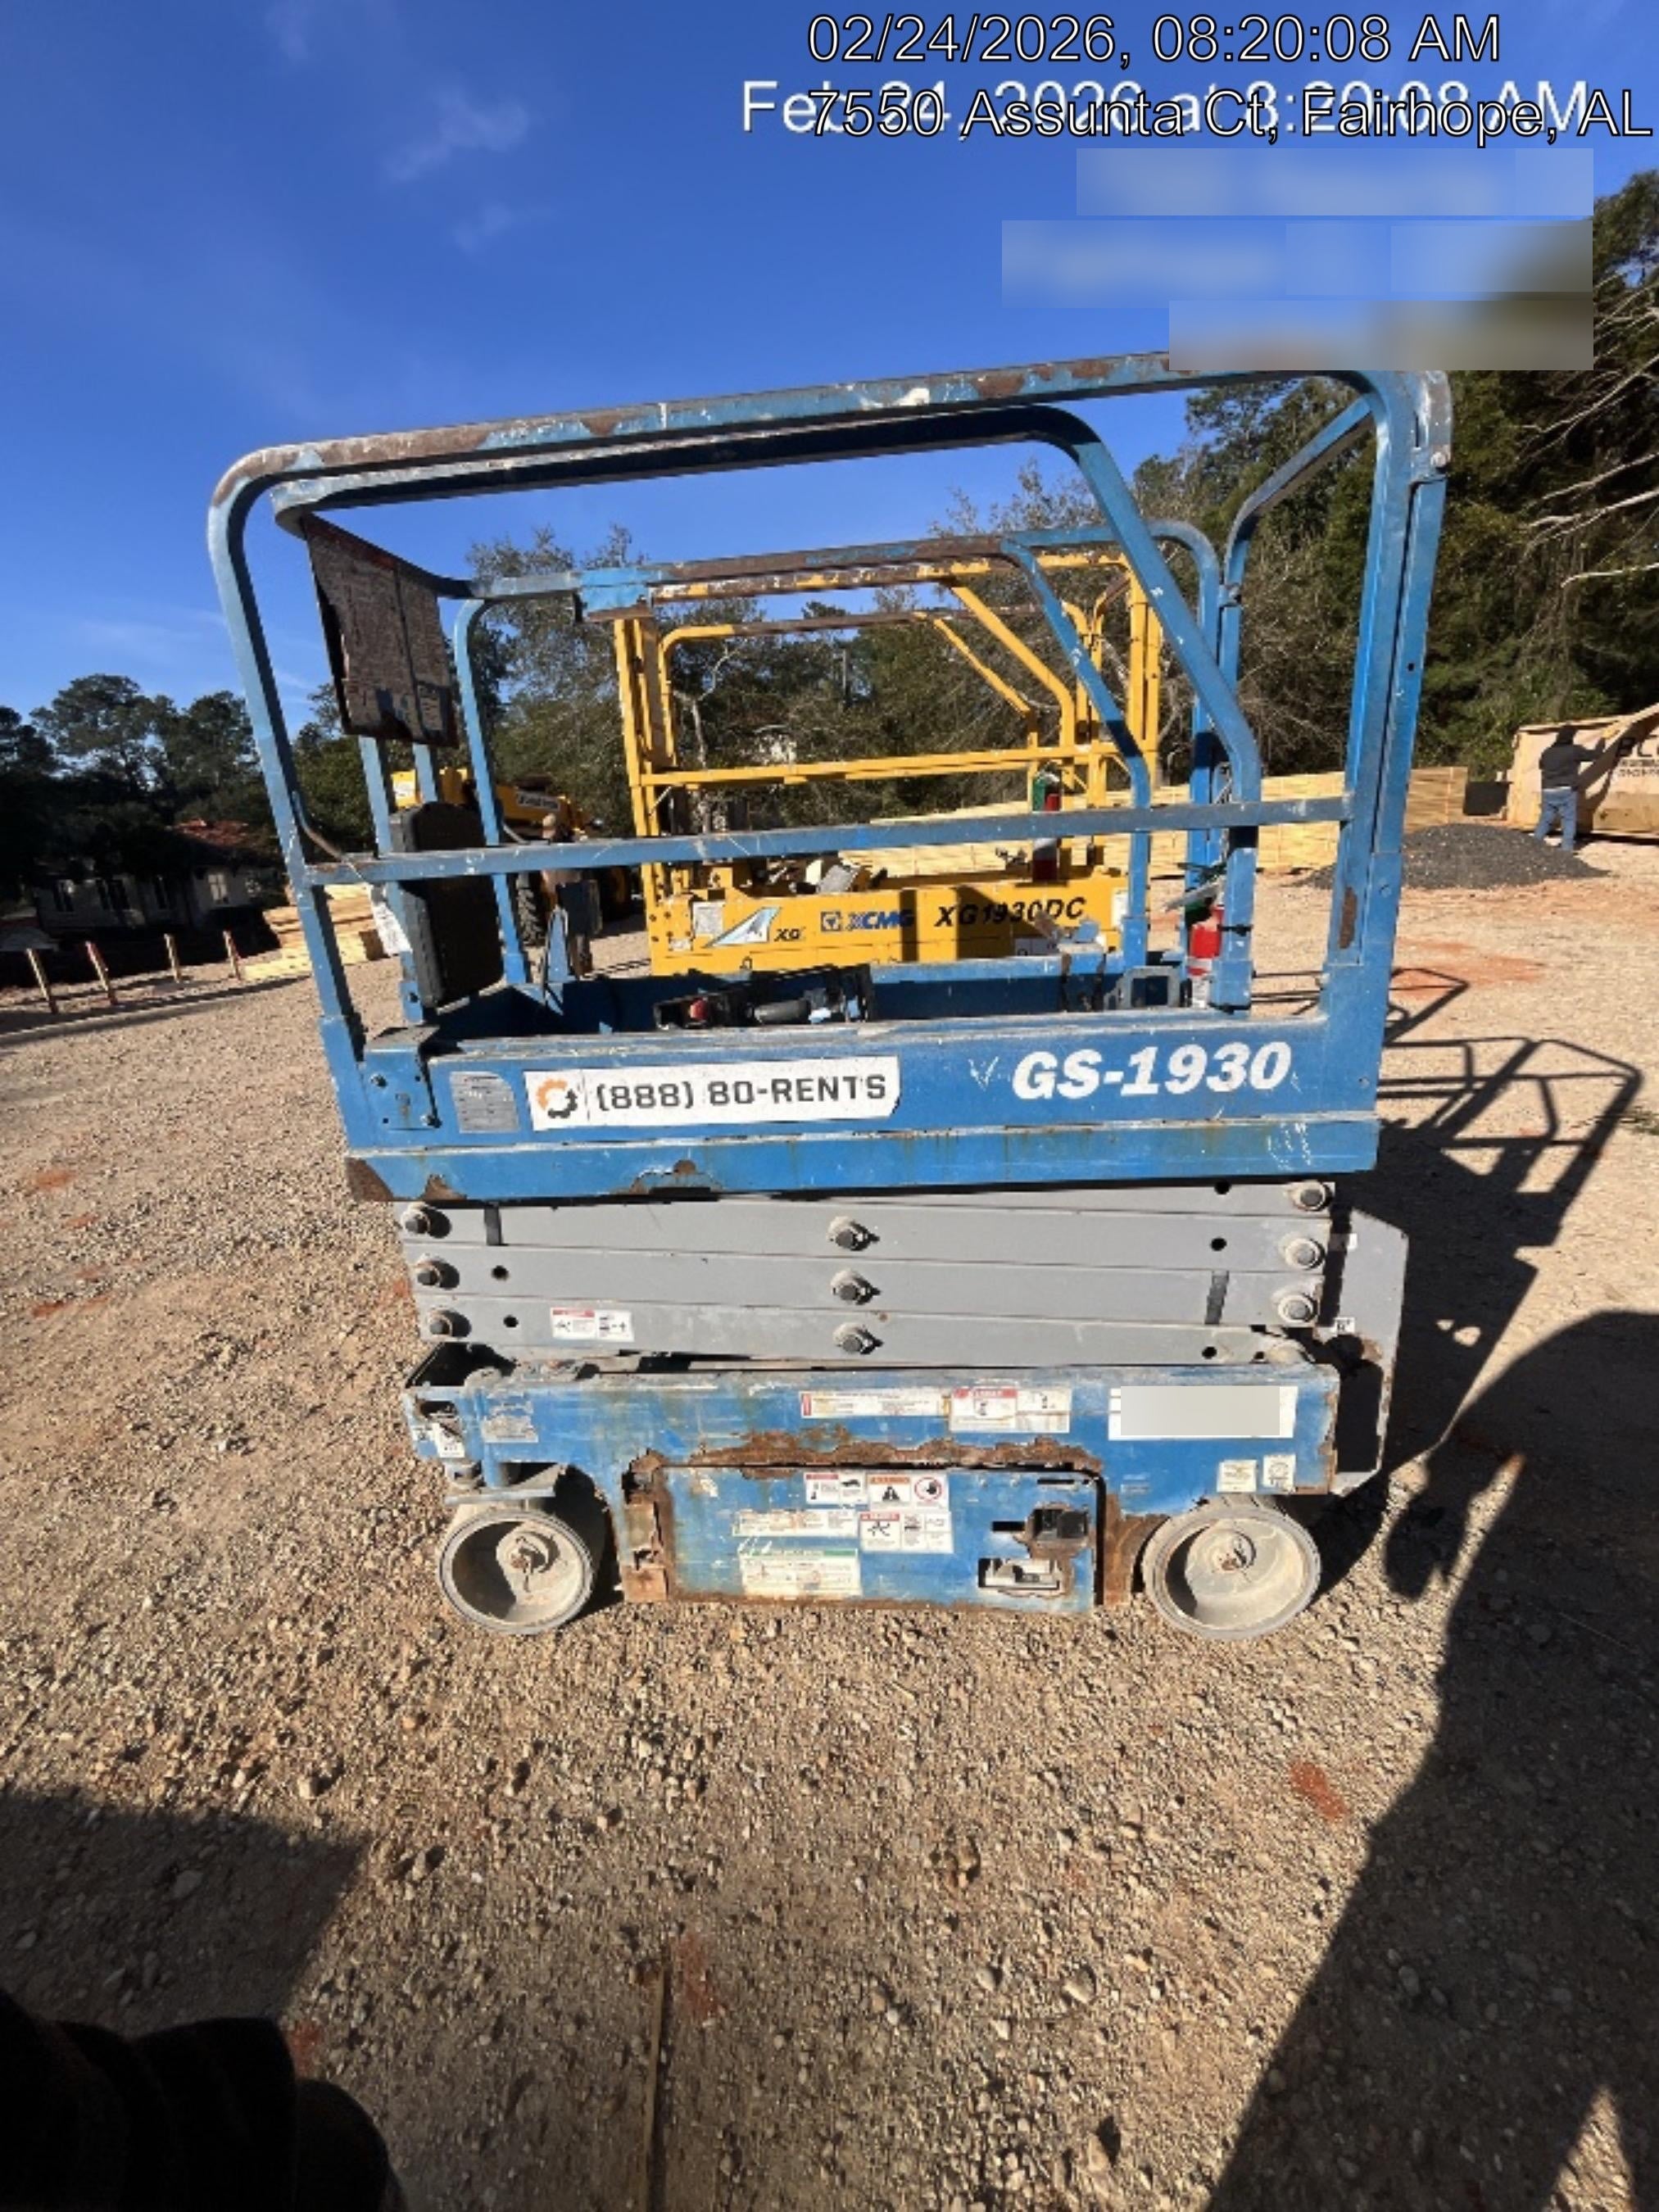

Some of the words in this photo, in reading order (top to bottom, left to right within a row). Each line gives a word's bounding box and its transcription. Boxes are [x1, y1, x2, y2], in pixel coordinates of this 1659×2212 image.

[847, 909, 915, 931] XCMG
[1012, 1040, 1292, 1100] GS-1930
[596, 1081, 695, 1112] (888)
[707, 1074, 886, 1106] 80-RENTS
